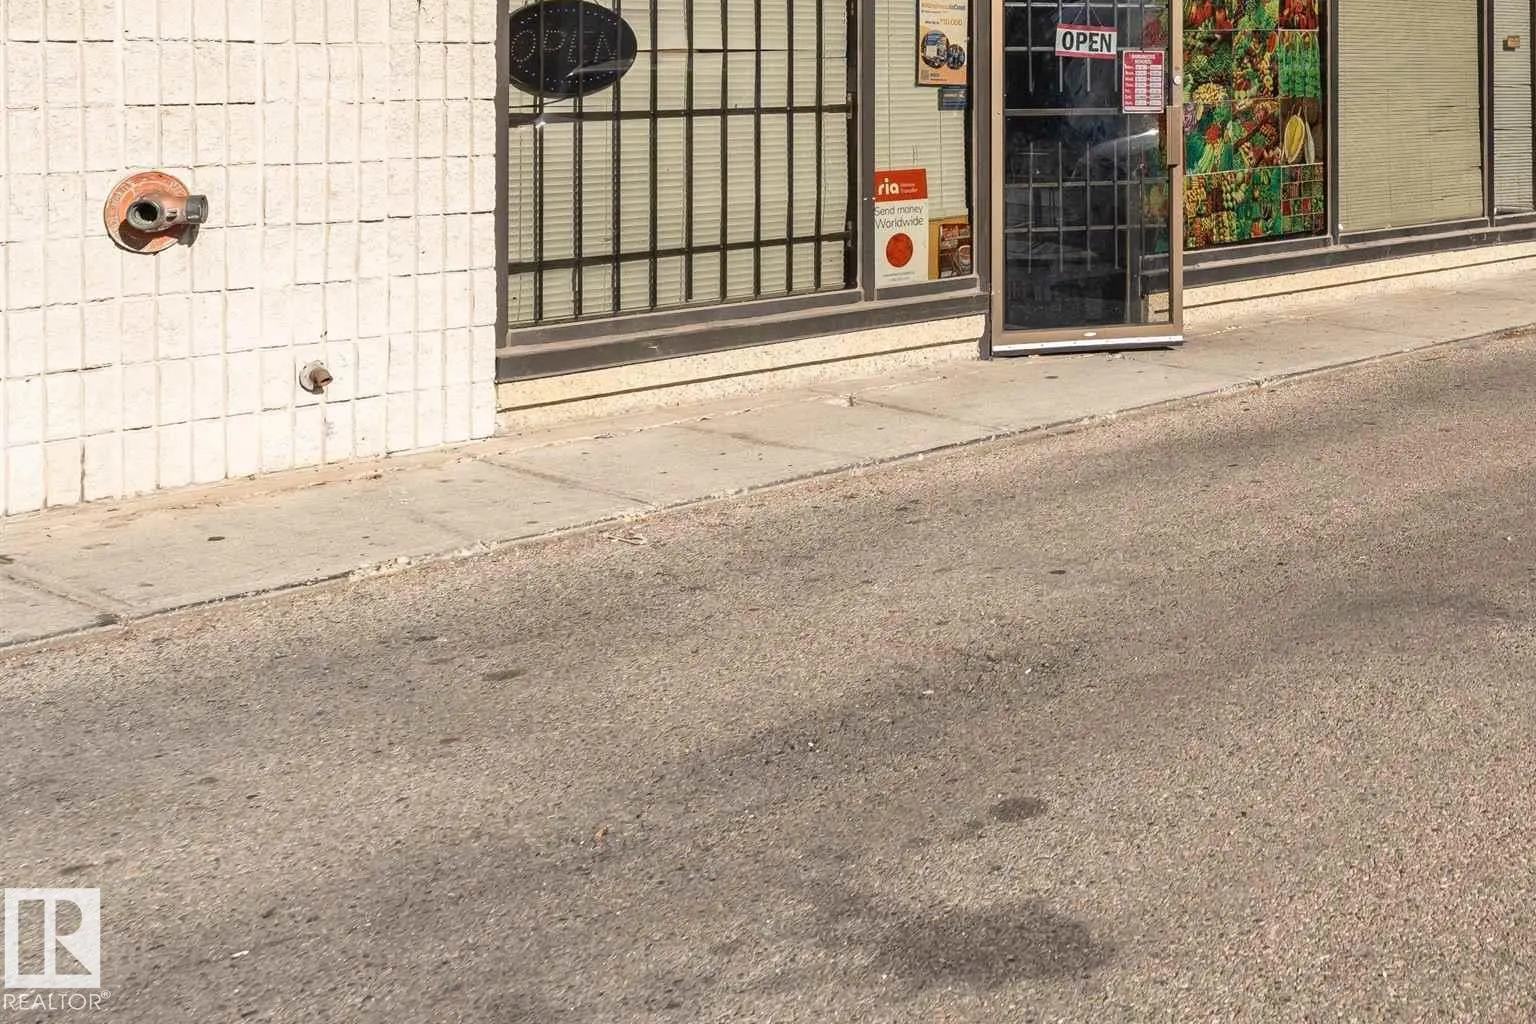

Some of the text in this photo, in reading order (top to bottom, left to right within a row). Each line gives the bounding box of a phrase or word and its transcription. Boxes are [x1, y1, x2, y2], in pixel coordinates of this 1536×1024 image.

[1062, 31, 1112, 53] OPEN
[878, 178, 900, 195] ria
[874, 204, 924, 217] Send money
[874, 216, 924, 230] Worldwide
